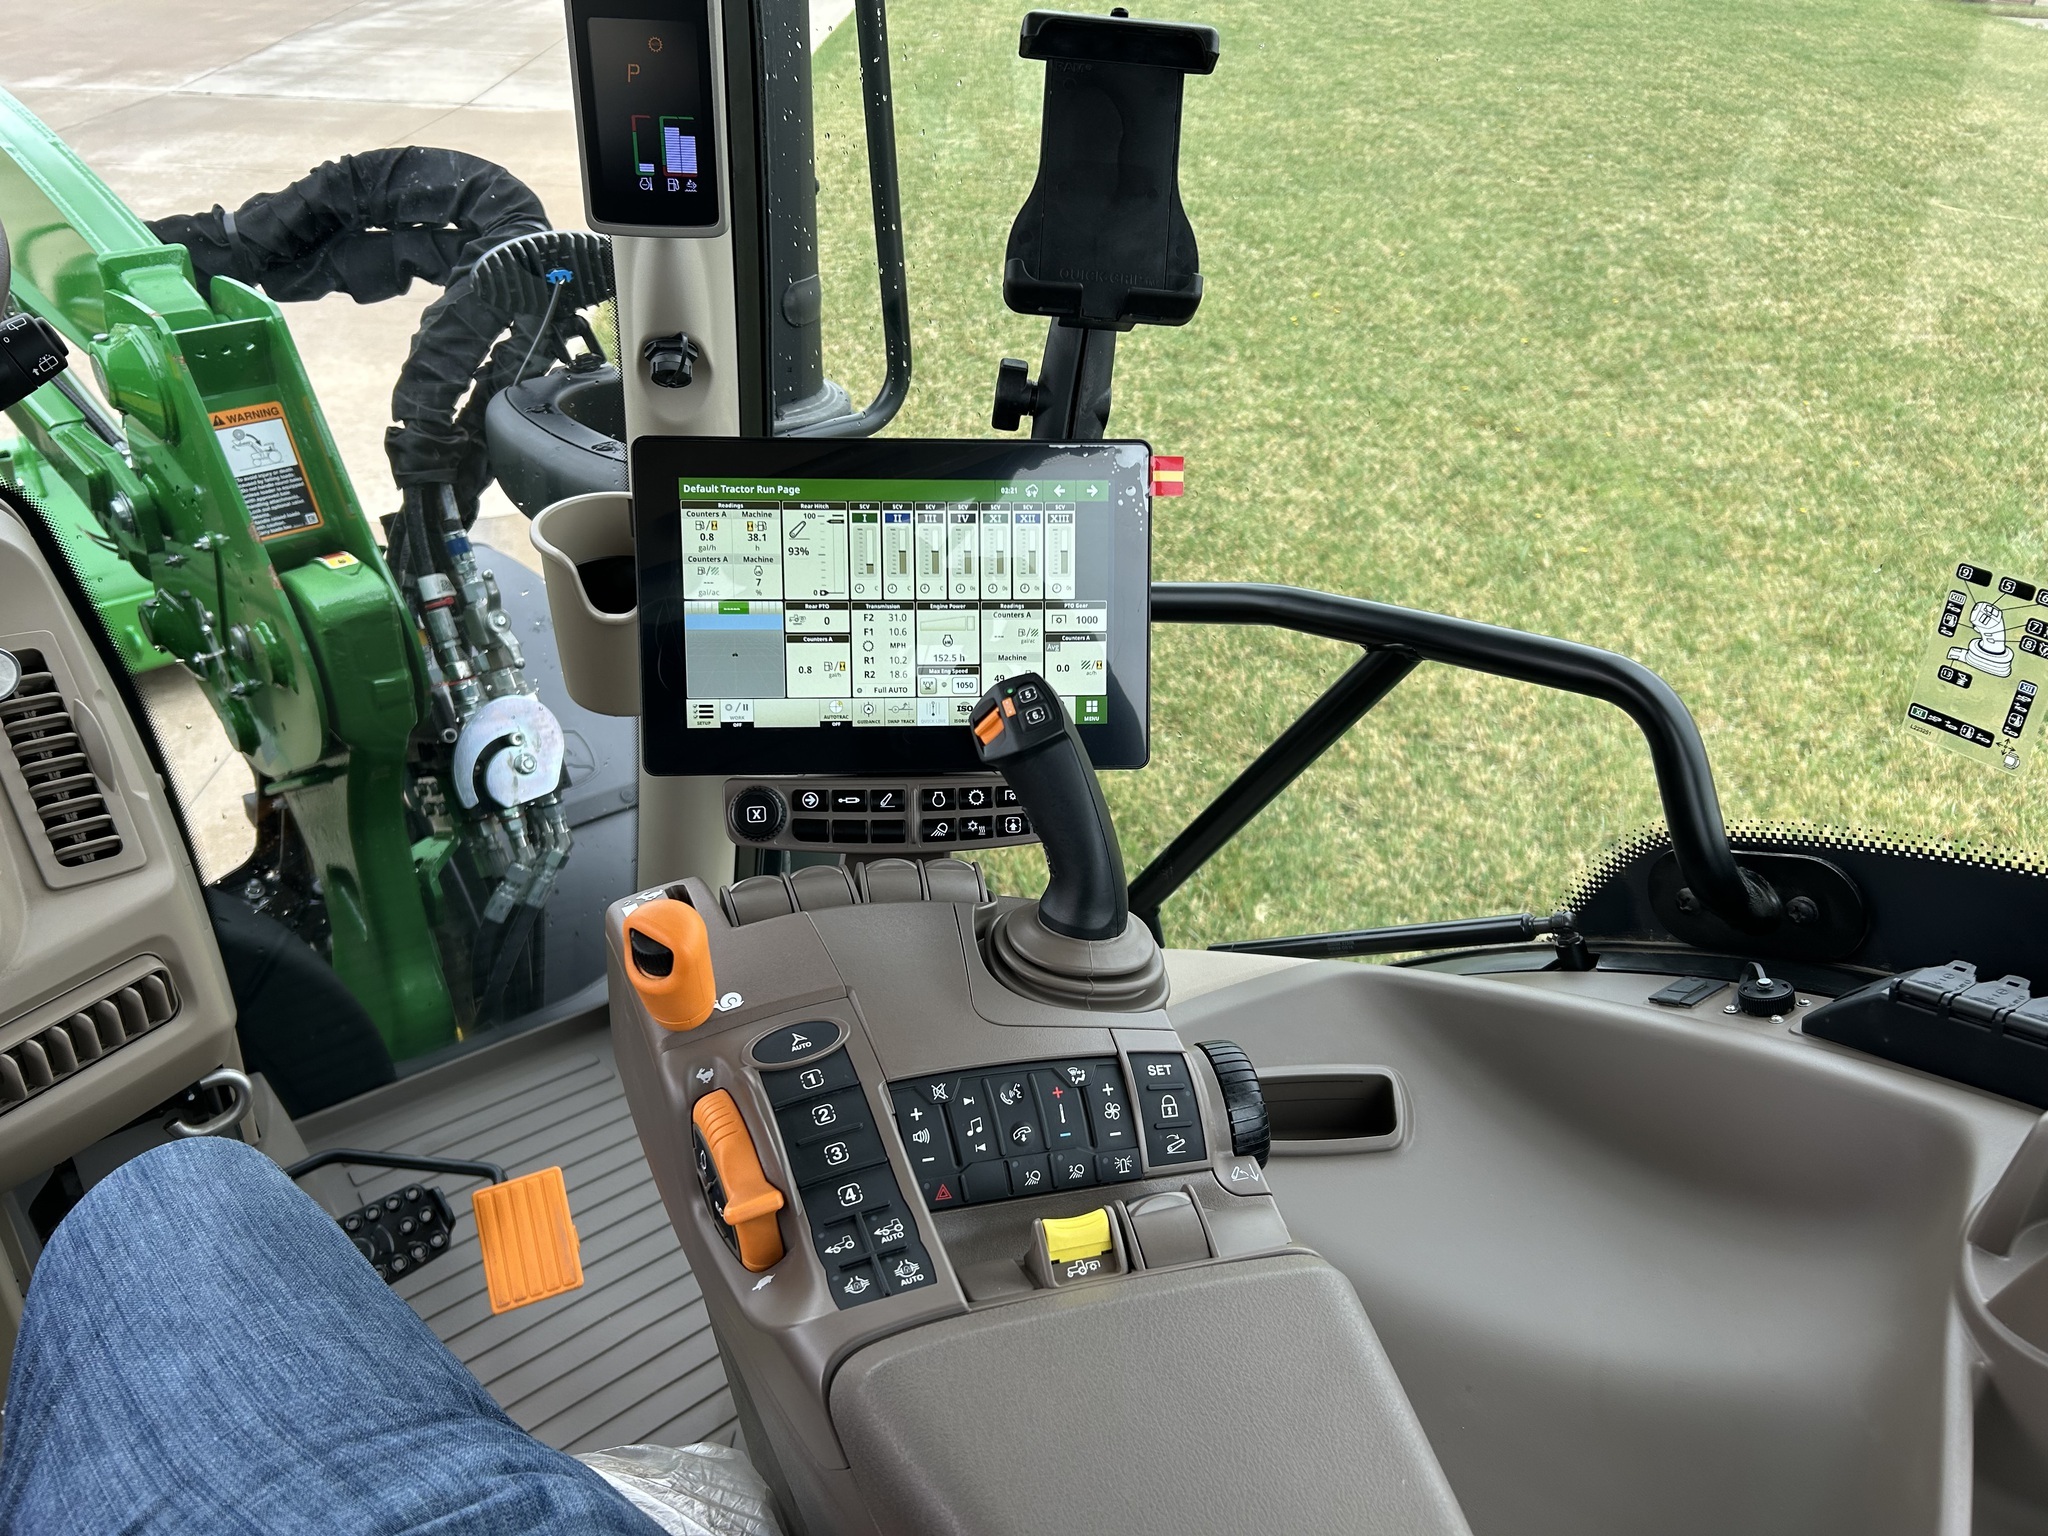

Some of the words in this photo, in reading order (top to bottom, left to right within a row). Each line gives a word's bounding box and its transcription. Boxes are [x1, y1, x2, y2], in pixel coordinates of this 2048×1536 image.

[627, 63, 641, 83] P
[226, 407, 280, 424] WARNING
[683, 484, 719, 494] Default
[720, 484, 755, 495] Tractor
[756, 485, 775, 494] Run
[777, 485, 801, 496] Page
[686, 510, 721, 518] Counters
[721, 510, 728, 518] A
[862, 514, 867, 523] I
[893, 514, 902, 523] II
[924, 514, 937, 523] III
[957, 514, 970, 523] IV
[989, 514, 1002, 523] XI
[1020, 514, 1036, 523] XII
[1050, 514, 1070, 523] XIII
[700, 533, 715, 541] 0.8
[747, 533, 767, 541] 38.1
[698, 544, 717, 553] gal/h
[788, 547, 810, 556] 93%
[743, 556, 774, 564] Machine
[1961, 568, 1970, 577] 9
[755, 578, 761, 586] 7
[2004, 582, 2013, 591] 5
[930, 603, 948, 611] Engine
[824, 616, 830, 625] 0
[863, 613, 875, 622] F2
[888, 613, 907, 622] 31.0
[1076, 615, 1099, 624] 1000
[863, 627, 874, 636] F1
[889, 627, 908, 636] 10.6
[2031, 623, 2039, 631] 7
[1046, 643, 1060, 652] Avg
[2024, 640, 2033, 649] 8
[863, 656, 875, 665] R1
[889, 656, 908, 665] 10.2
[933, 653, 957, 662] 152.5
[959, 653, 965, 662] h
[798, 665, 813, 674] 0.8
[951, 668, 969, 676] Speed
[1056, 664, 1070, 673] 0.0
[864, 670, 876, 679] R2
[889, 670, 908, 679] 18.6
[956, 681, 974, 689] 1050
[873, 686, 887, 694] Full
[887, 686, 909, 694] AUTO
[1024, 690, 1032, 699] 5
[752, 809, 762, 820] X
[791, 1040, 812, 1052] AUTO
[1147, 1064, 1172, 1076] SET
[807, 1074, 816, 1086] 1
[818, 1109, 830, 1121] 2
[831, 1147, 843, 1161] 3
[845, 1188, 857, 1201] 4
[880, 1231, 904, 1244] AUTO
[900, 1273, 924, 1287] AUTO
